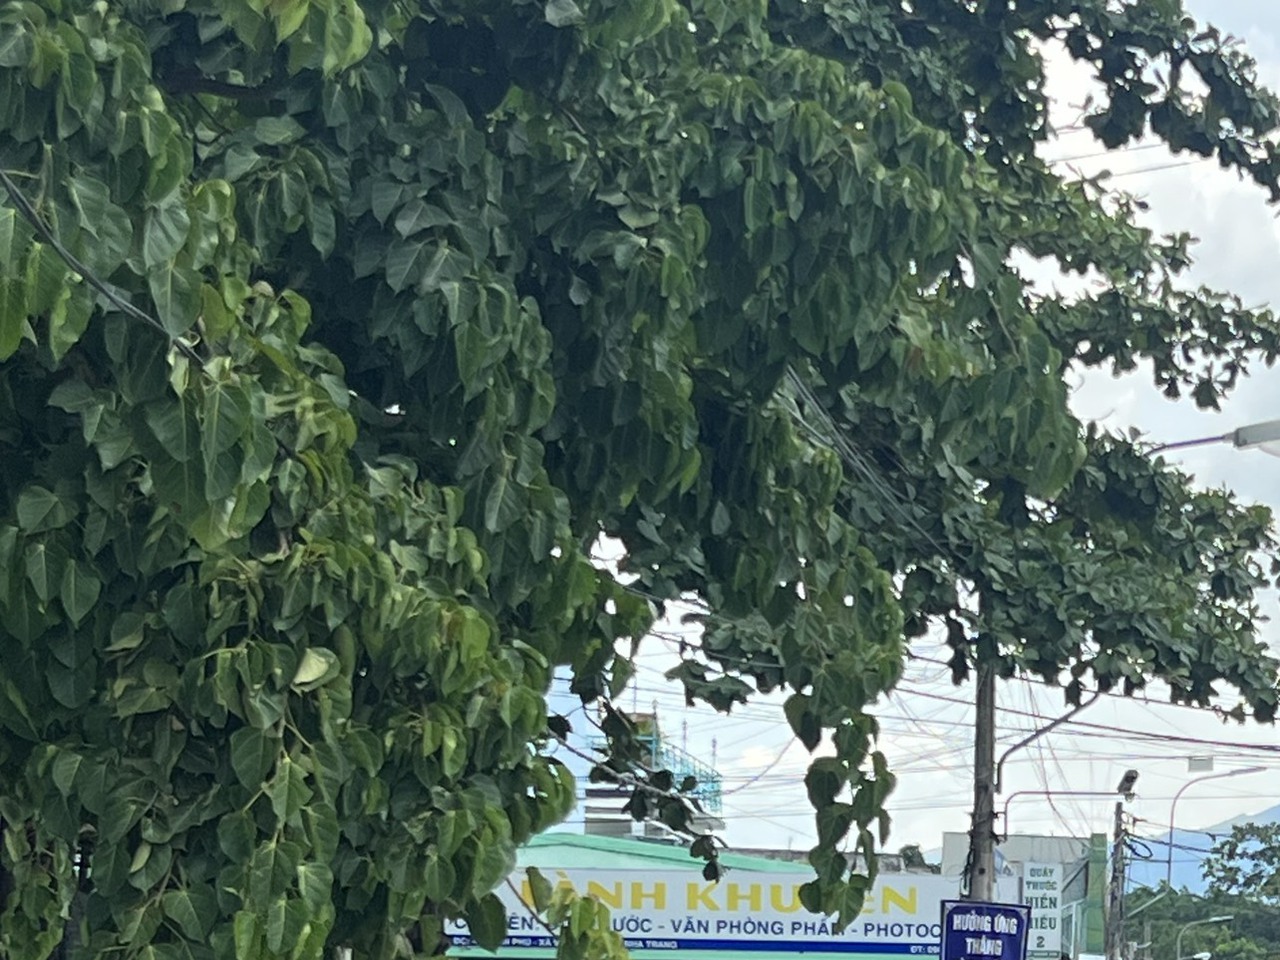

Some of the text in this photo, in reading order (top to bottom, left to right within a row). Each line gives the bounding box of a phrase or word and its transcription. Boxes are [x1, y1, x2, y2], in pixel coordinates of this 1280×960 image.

[686, 882, 917, 914] KHUN
[613, 915, 653, 932] ƯỚC
[671, 916, 709, 933] VĂN
[716, 916, 784, 935] PHÒNG
[953, 909, 1018, 935] HƯỞNG ỨNG
[645, 941, 678, 949] TRANG
[966, 937, 1003, 955] THÁNG
[1036, 936, 1045, 948] 2
